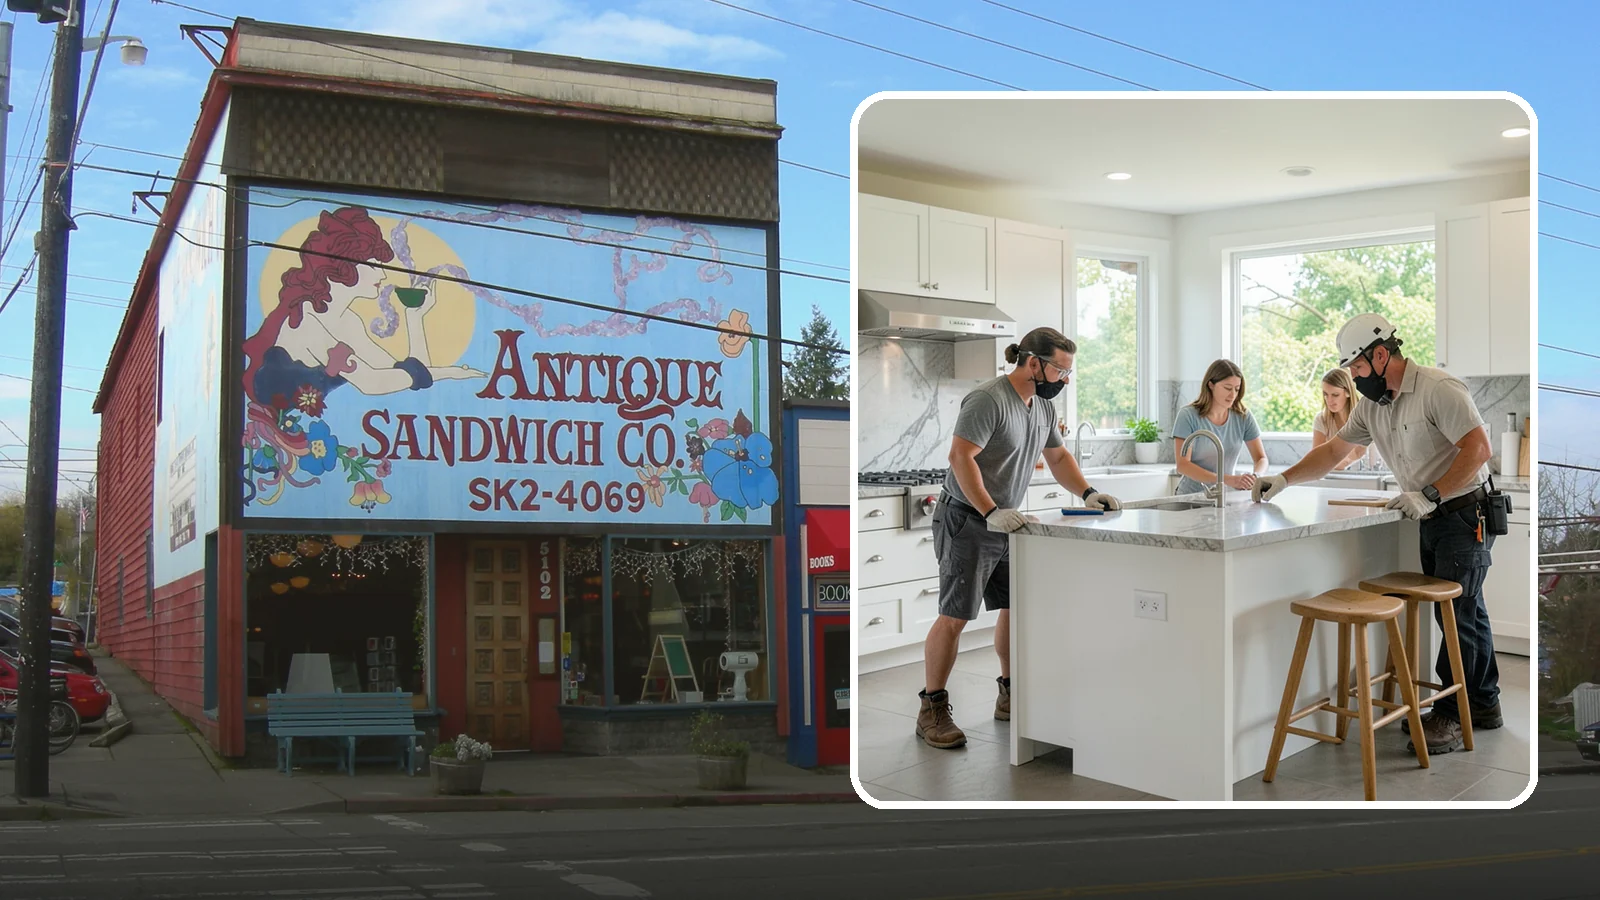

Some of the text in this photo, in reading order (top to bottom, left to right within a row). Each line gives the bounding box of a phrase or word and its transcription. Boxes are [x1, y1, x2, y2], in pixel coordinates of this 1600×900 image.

[476, 329, 723, 420] ANTIQUE
[361, 409, 684, 467] SANDWICH CO.
[468, 477, 645, 513] SK2-4069
[539, 541, 551, 600] 5102
[809, 555, 834, 569] BOOKS
